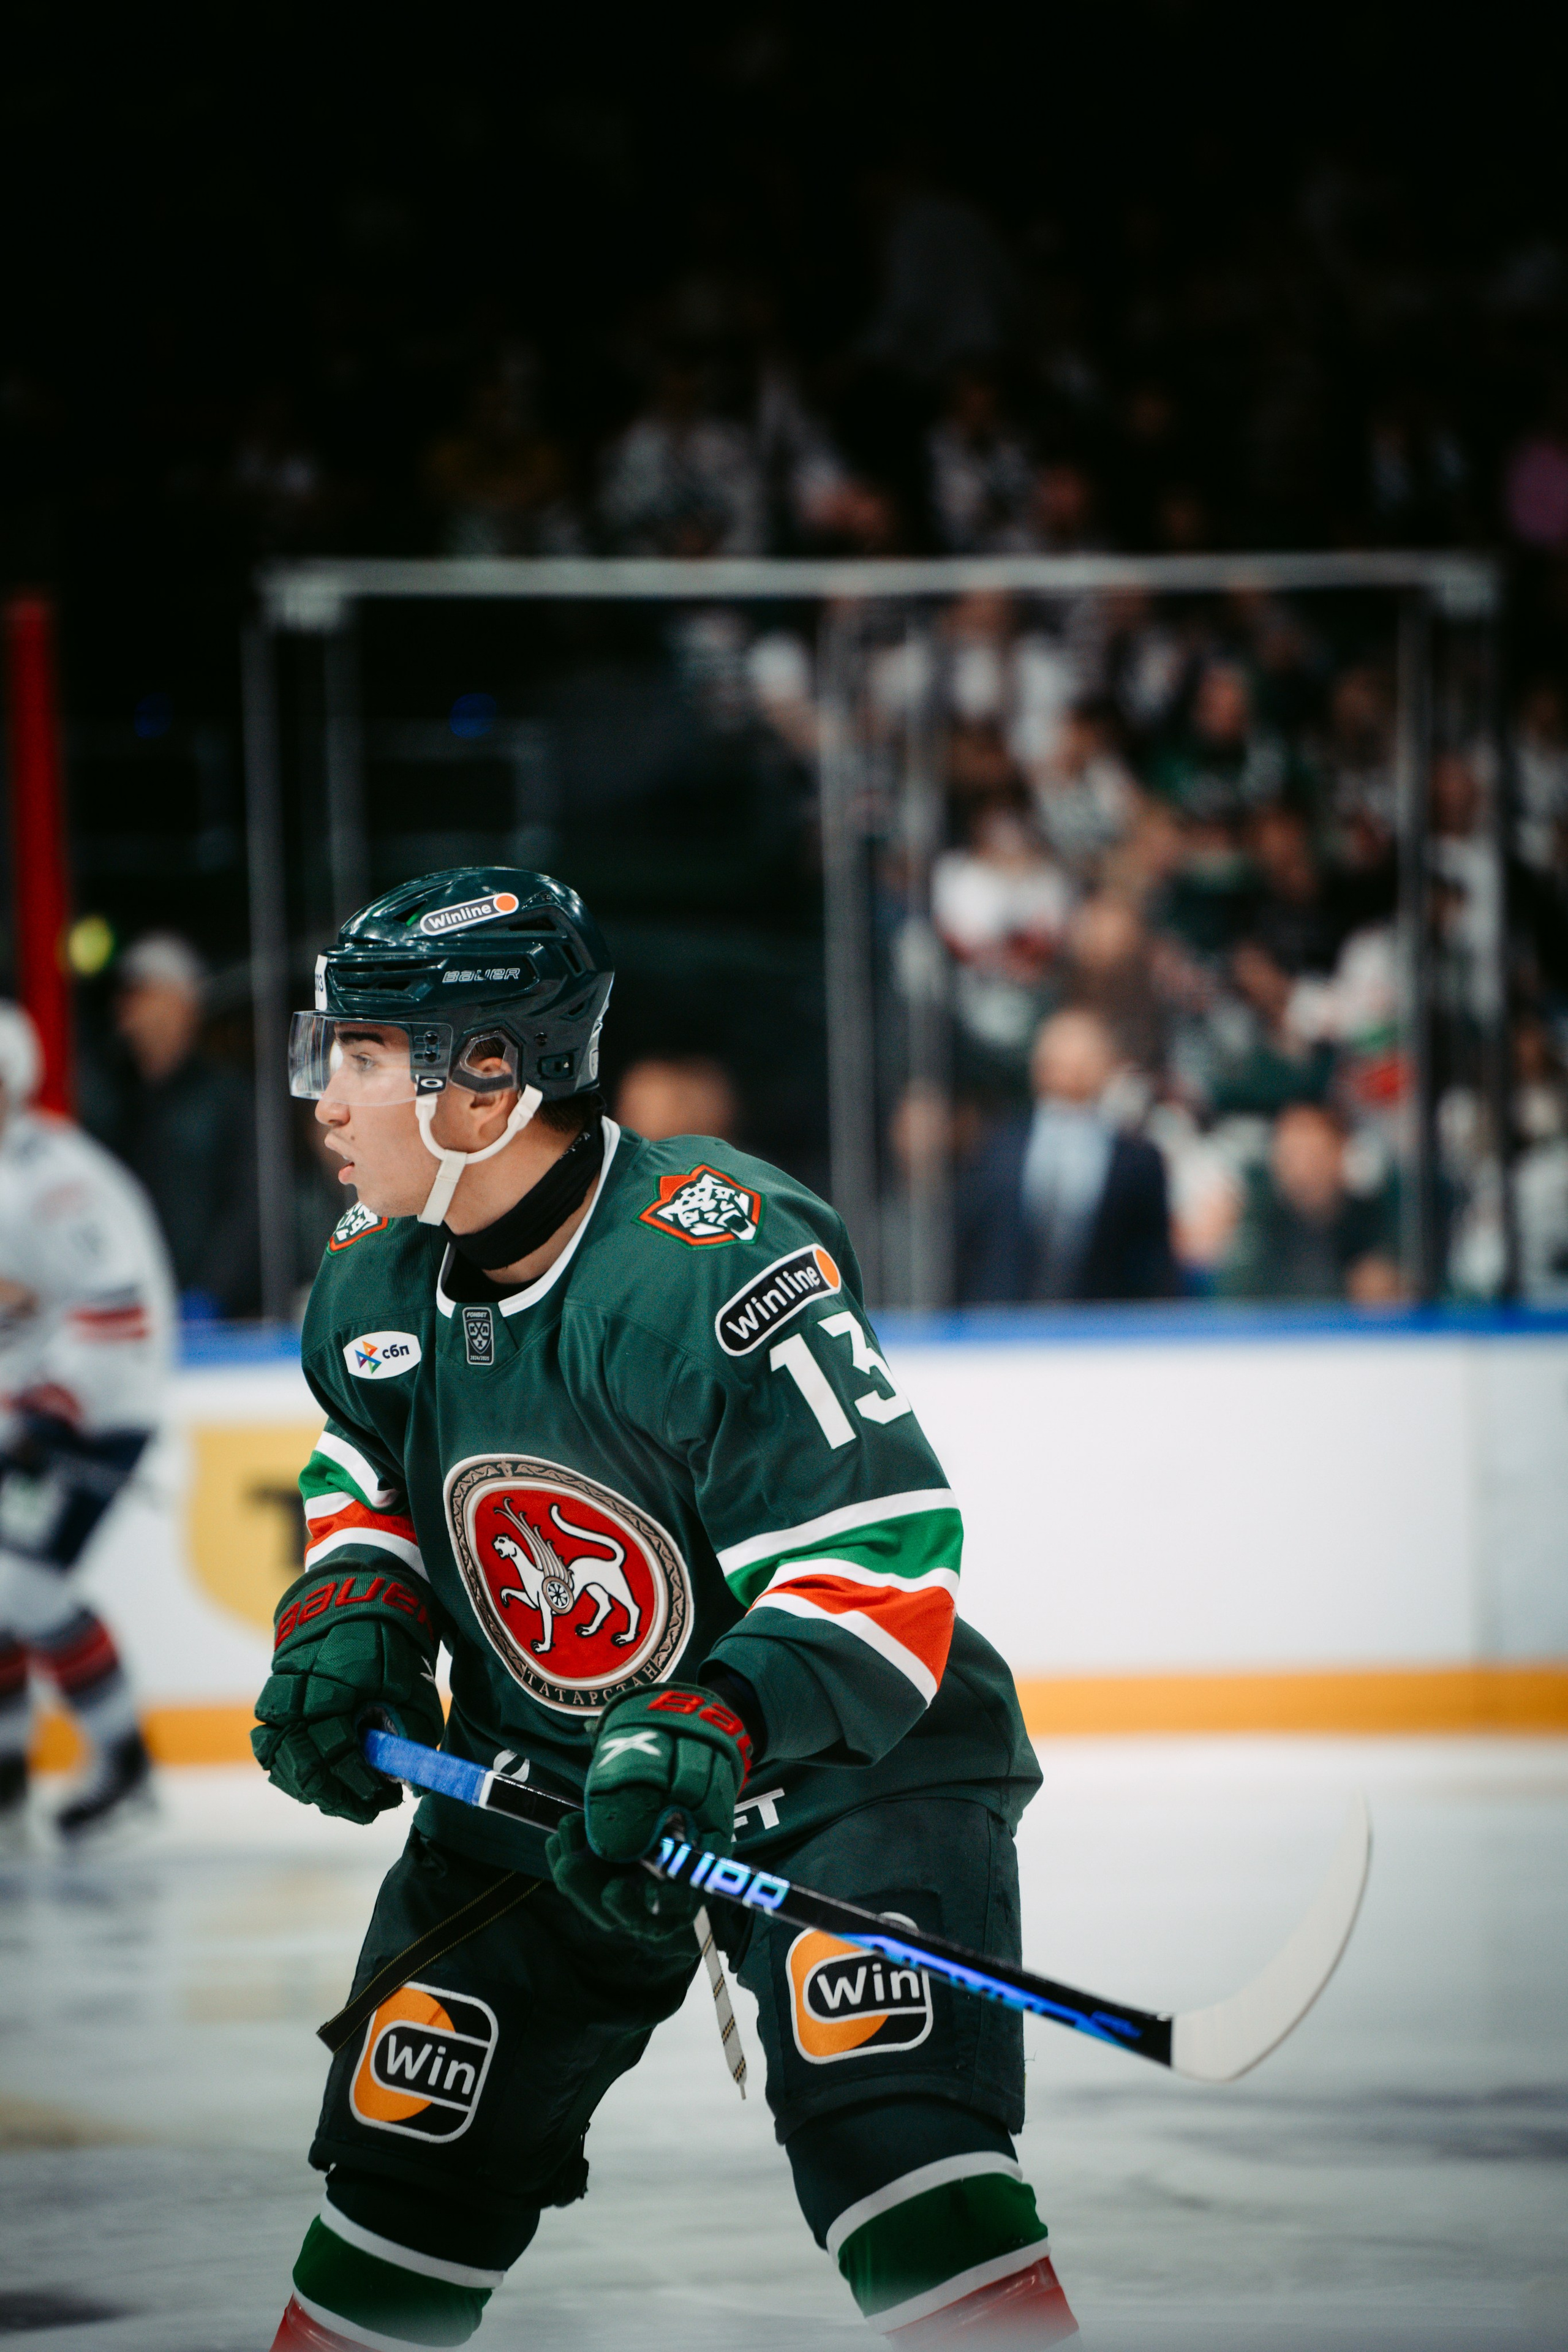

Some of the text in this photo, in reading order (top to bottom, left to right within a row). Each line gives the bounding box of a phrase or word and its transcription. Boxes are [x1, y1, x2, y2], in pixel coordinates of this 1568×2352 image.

[428, 904, 492, 930] Winline
[726, 1264, 821, 1340] Winline
[769, 1311, 912, 1450] 13
[816, 1962, 921, 2010] Win
[386, 2034, 476, 2095] Win
